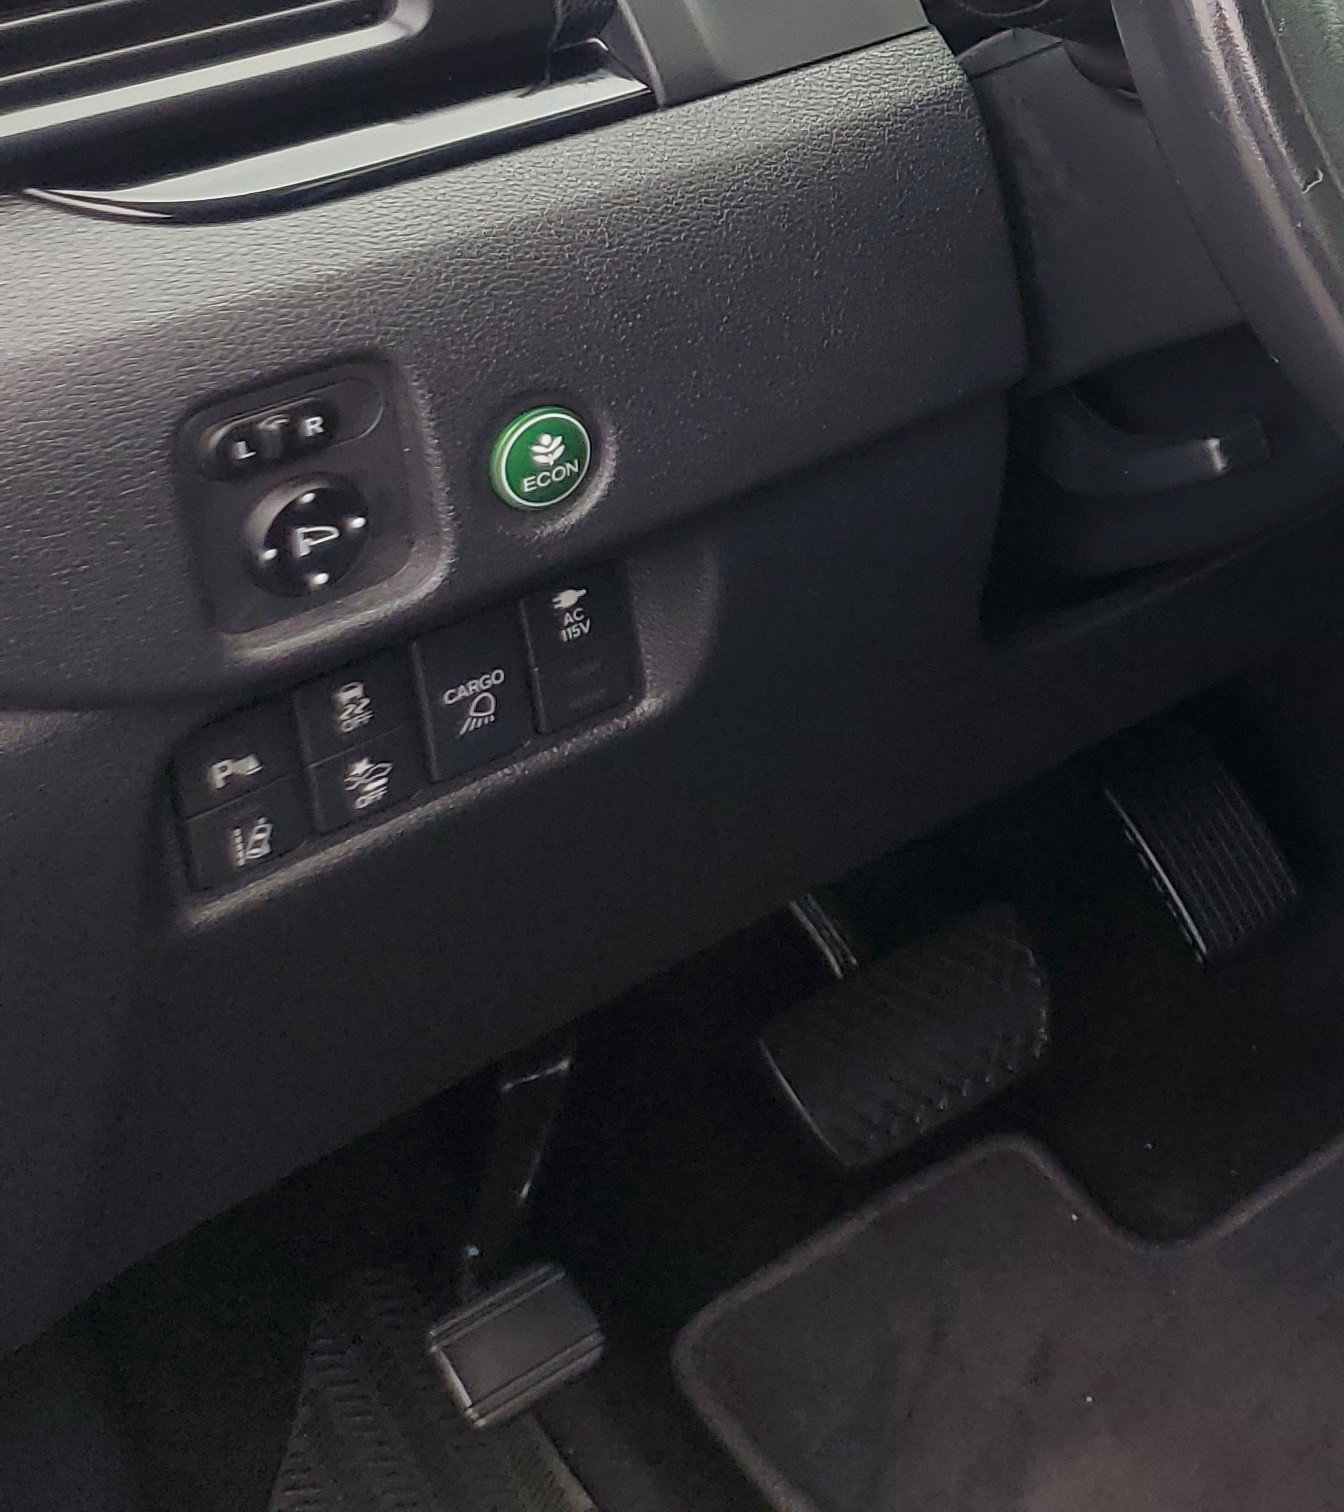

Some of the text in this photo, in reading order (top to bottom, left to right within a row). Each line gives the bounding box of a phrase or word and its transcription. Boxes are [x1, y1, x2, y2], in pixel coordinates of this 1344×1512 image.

[235, 415, 326, 460] L R
[522, 458, 579, 493] ECON
[563, 607, 585, 626] AC
[559, 619, 592, 642] 115V
[442, 669, 505, 705] CARGO
[341, 710, 375, 733] OFF
[354, 786, 388, 810] OFF
